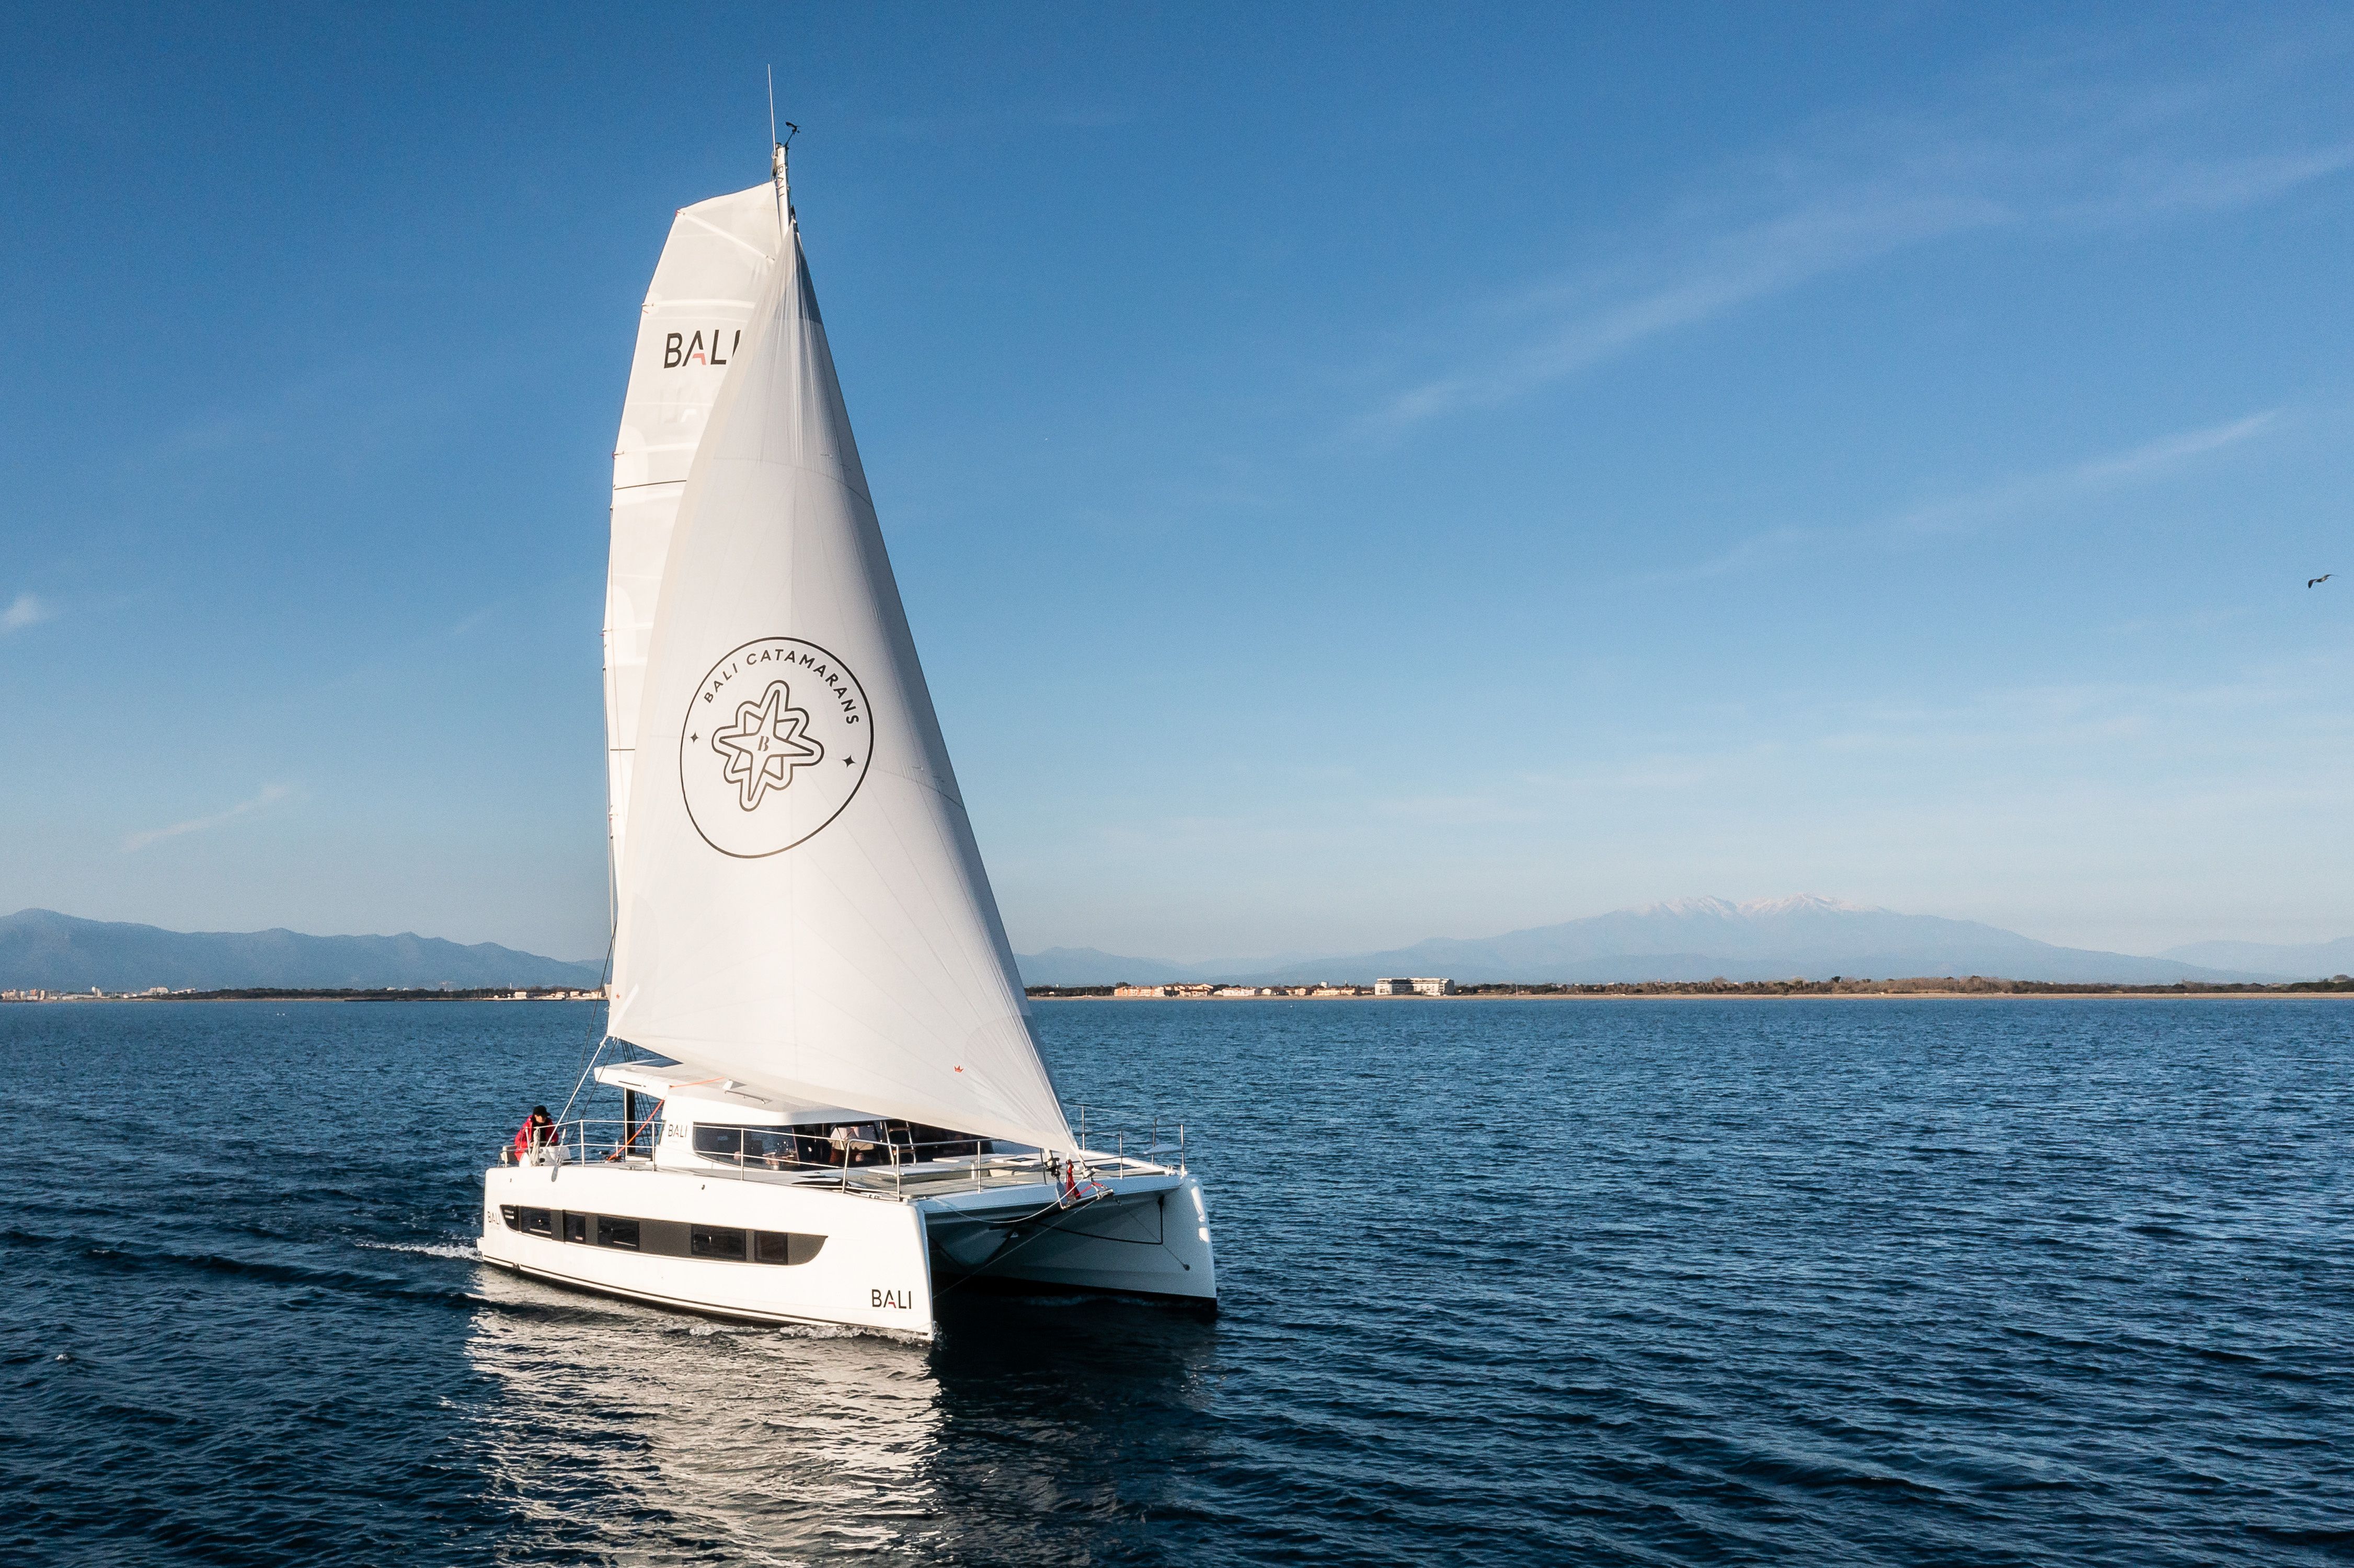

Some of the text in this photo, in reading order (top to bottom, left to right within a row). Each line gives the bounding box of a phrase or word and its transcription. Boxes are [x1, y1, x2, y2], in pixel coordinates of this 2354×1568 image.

[704, 649, 859, 725] BALI CATAMARANS
[757, 735, 770, 752] B
[668, 1124, 687, 1138] BALI
[487, 1211, 501, 1225] BALI
[871, 1289, 912, 1309] BALI
